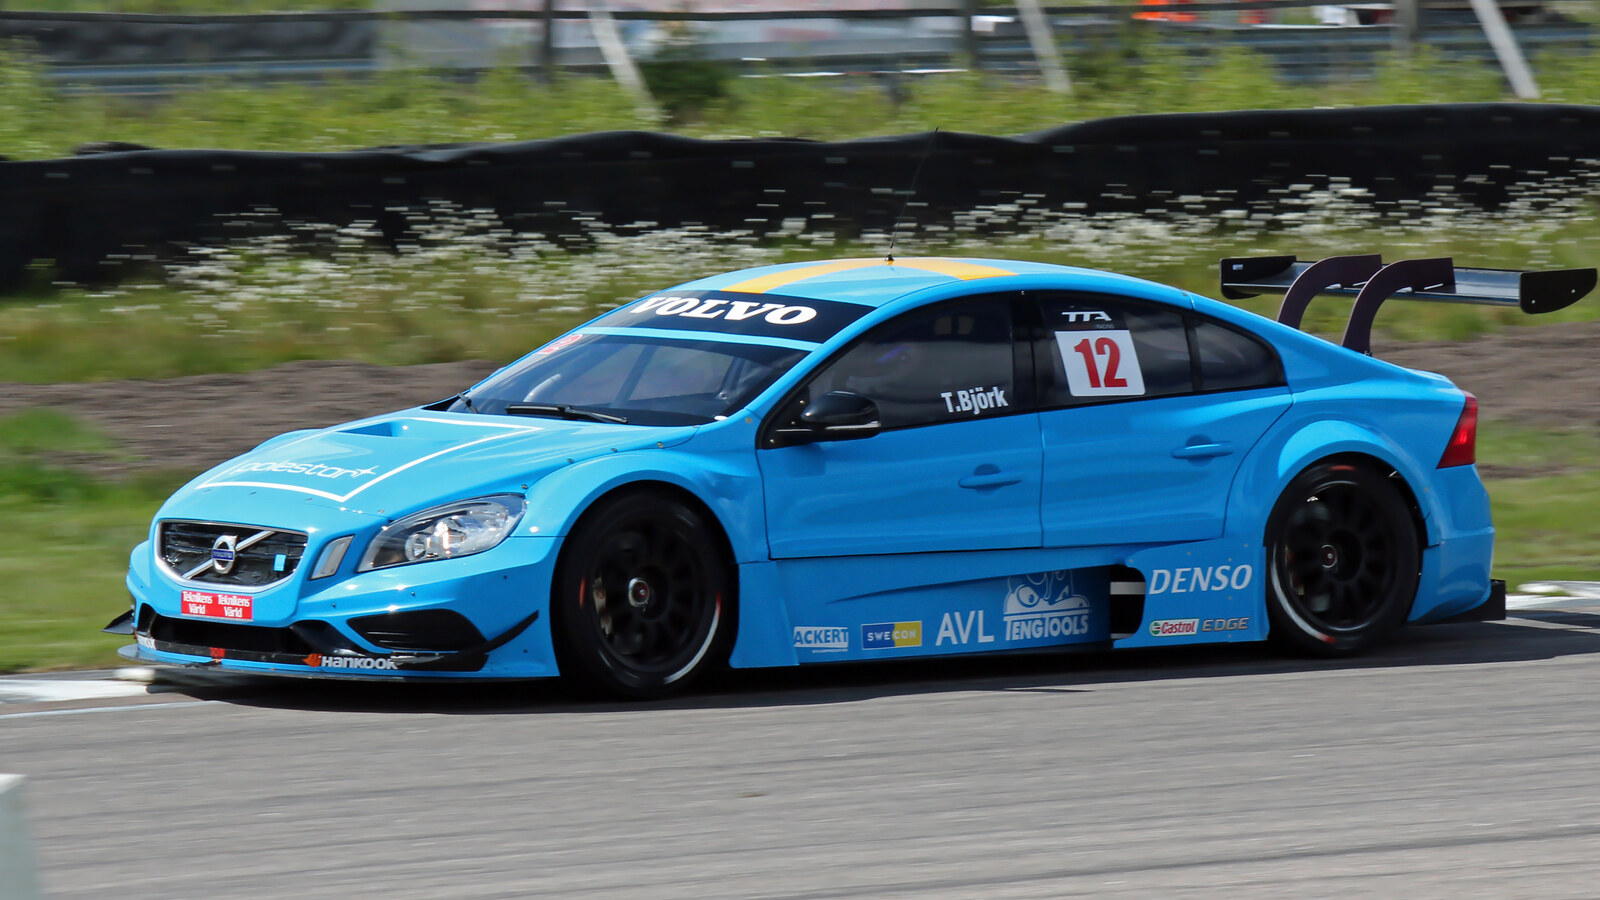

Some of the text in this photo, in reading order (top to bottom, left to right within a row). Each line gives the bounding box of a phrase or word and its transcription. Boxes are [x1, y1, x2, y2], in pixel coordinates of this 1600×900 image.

[630, 297, 817, 325] VOLVO
[1061, 310, 1112, 322] TTA
[1073, 337, 1128, 388] 12
[941, 386, 1008, 415] T.Björk
[1149, 564, 1253, 595] DENSO
[182, 591, 213, 604] Teknikens
[218, 594, 251, 607] Teknikens
[188, 603, 206, 614] Värld
[224, 606, 243, 617] Värld
[935, 610, 995, 646] AVL
[1161, 618, 1250, 634] Castrol EDGE
[793, 628, 849, 645] ACKERT
